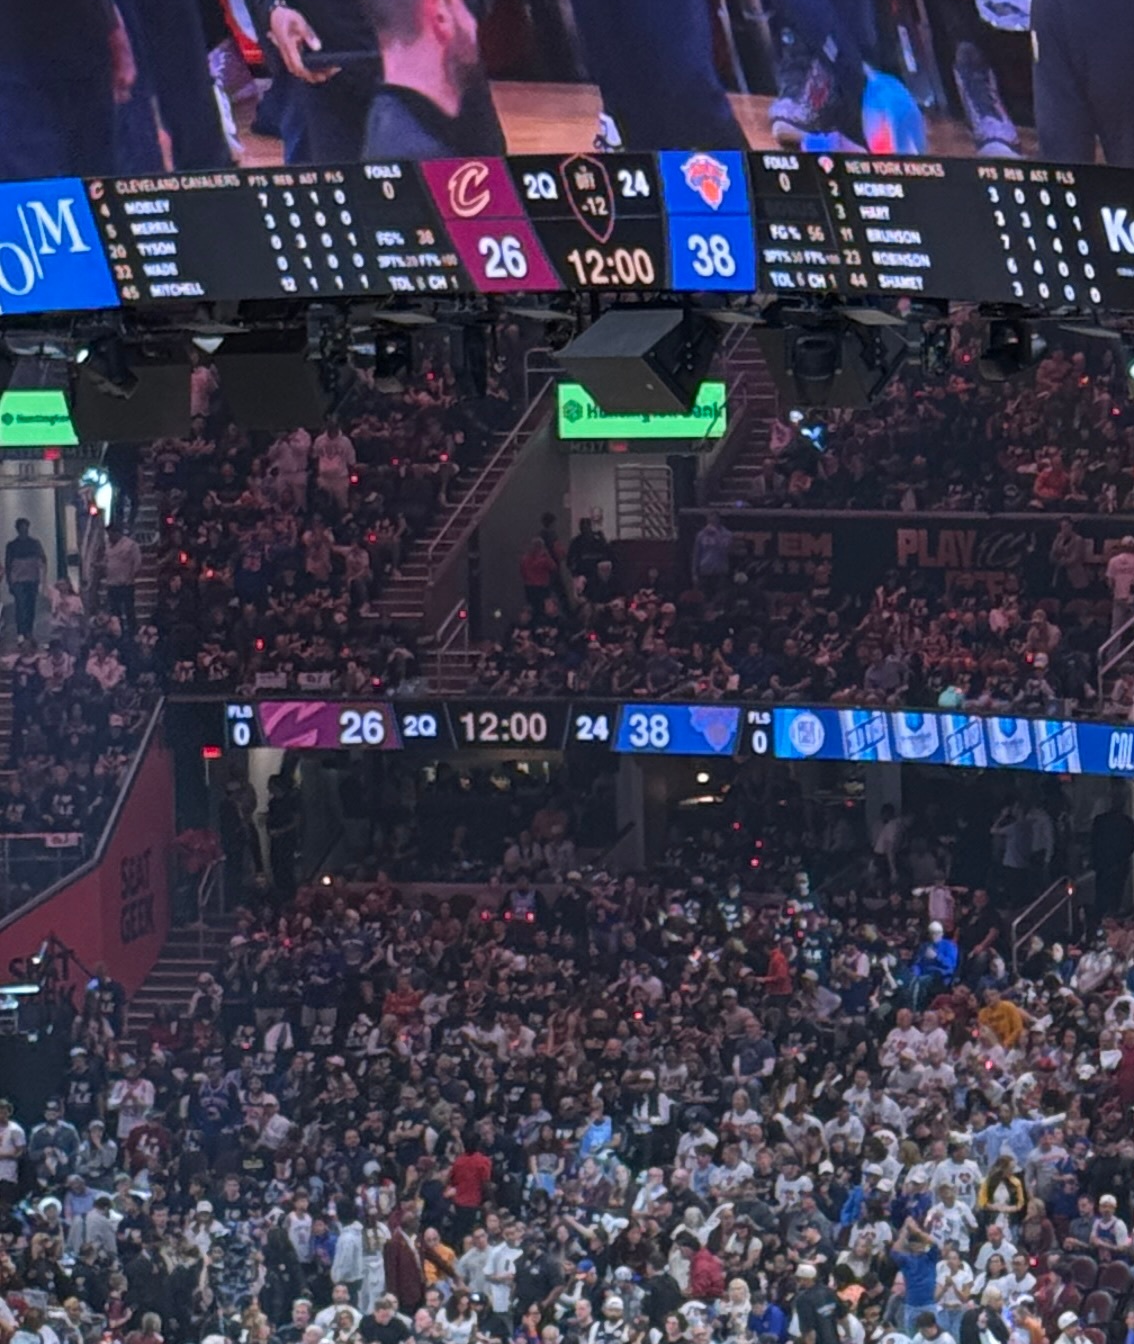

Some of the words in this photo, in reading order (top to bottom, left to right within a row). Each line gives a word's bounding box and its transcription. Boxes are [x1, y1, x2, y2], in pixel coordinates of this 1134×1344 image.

[364, 165, 402, 179] FOULS
[763, 156, 799, 171] FOULS
[523, 173, 558, 200] 2Q
[618, 170, 650, 198] 24
[476, 236, 528, 278] 26
[568, 248, 655, 286] 12:00
[688, 234, 737, 277] 38
[233, 723, 250, 747] 0
[339, 710, 385, 746] 26
[402, 714, 437, 739] 2Q
[459, 712, 548, 743] 12:00
[575, 715, 610, 741] 24
[628, 712, 671, 748] 38
[752, 729, 768, 754] 0
